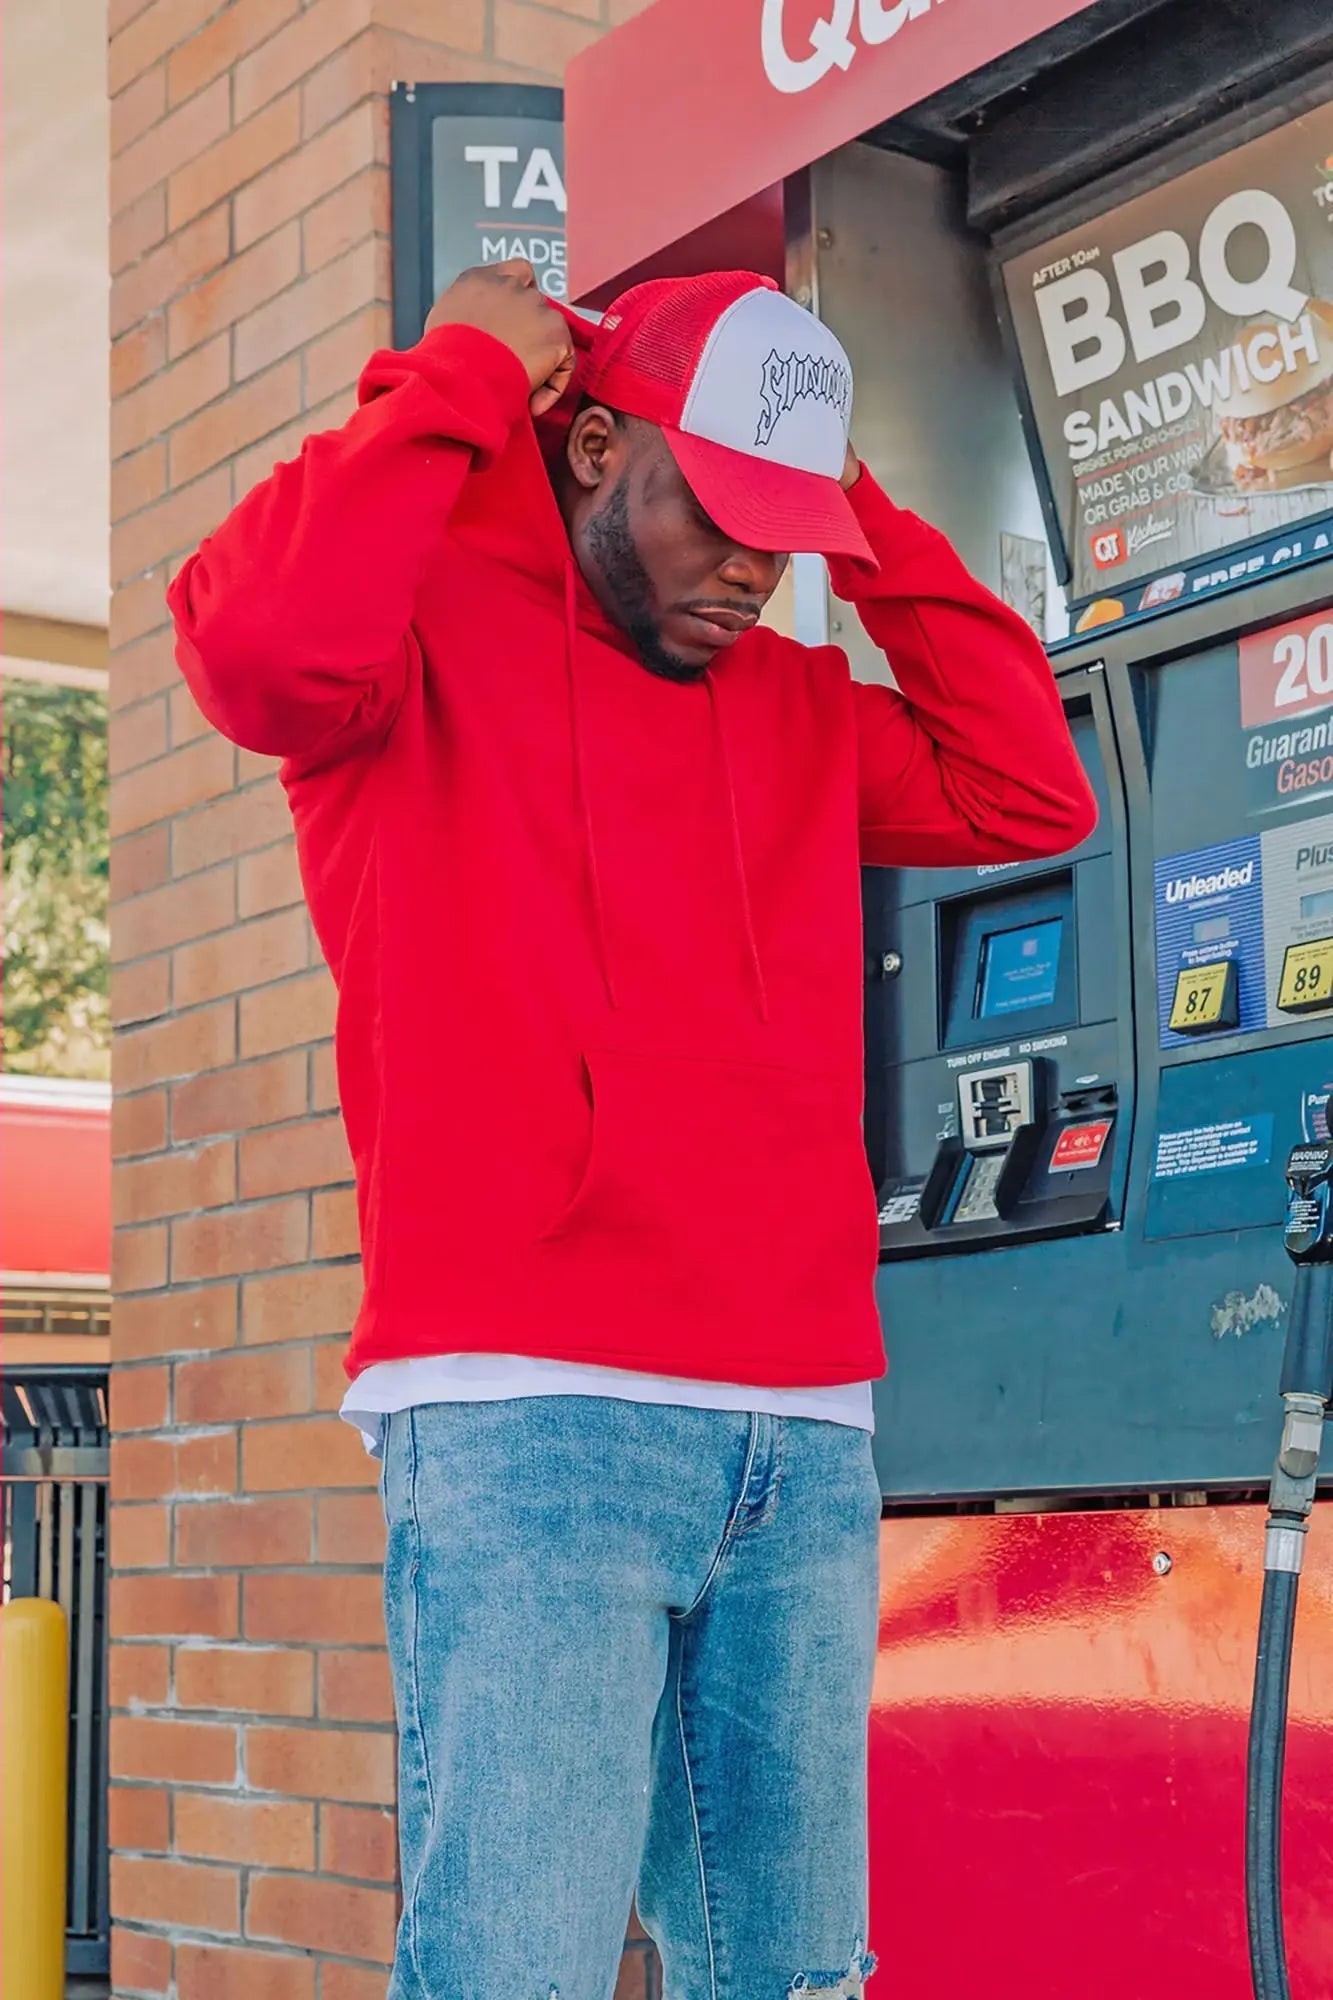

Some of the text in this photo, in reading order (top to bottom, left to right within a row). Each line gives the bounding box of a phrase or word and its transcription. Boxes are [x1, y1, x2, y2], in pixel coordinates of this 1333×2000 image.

[482, 236, 567, 266] MADE
[1032, 257, 1071, 287] AFTER
[1034, 189, 1309, 397] BBQ
[1063, 315, 1319, 460] SANDWICH
[1078, 447, 1204, 505] MADE YOUR WAY
[1084, 504, 1108, 526] OR
[1108, 488, 1152, 511] GRAB
[1168, 472, 1194, 494] GO
[1094, 534, 1119, 562] QT
[1273, 623, 1333, 708] 20
[1165, 861, 1253, 903] Unleaded
[1294, 965, 1321, 992] 89
[1186, 987, 1212, 1014] 87
[947, 1056, 967, 1068] TURN
[967, 1053, 982, 1064] OFF
[1019, 1042, 1032, 1053] NO
[1032, 1035, 1067, 1052] SMOKING
[1291, 1149, 1329, 1161] WARNING
